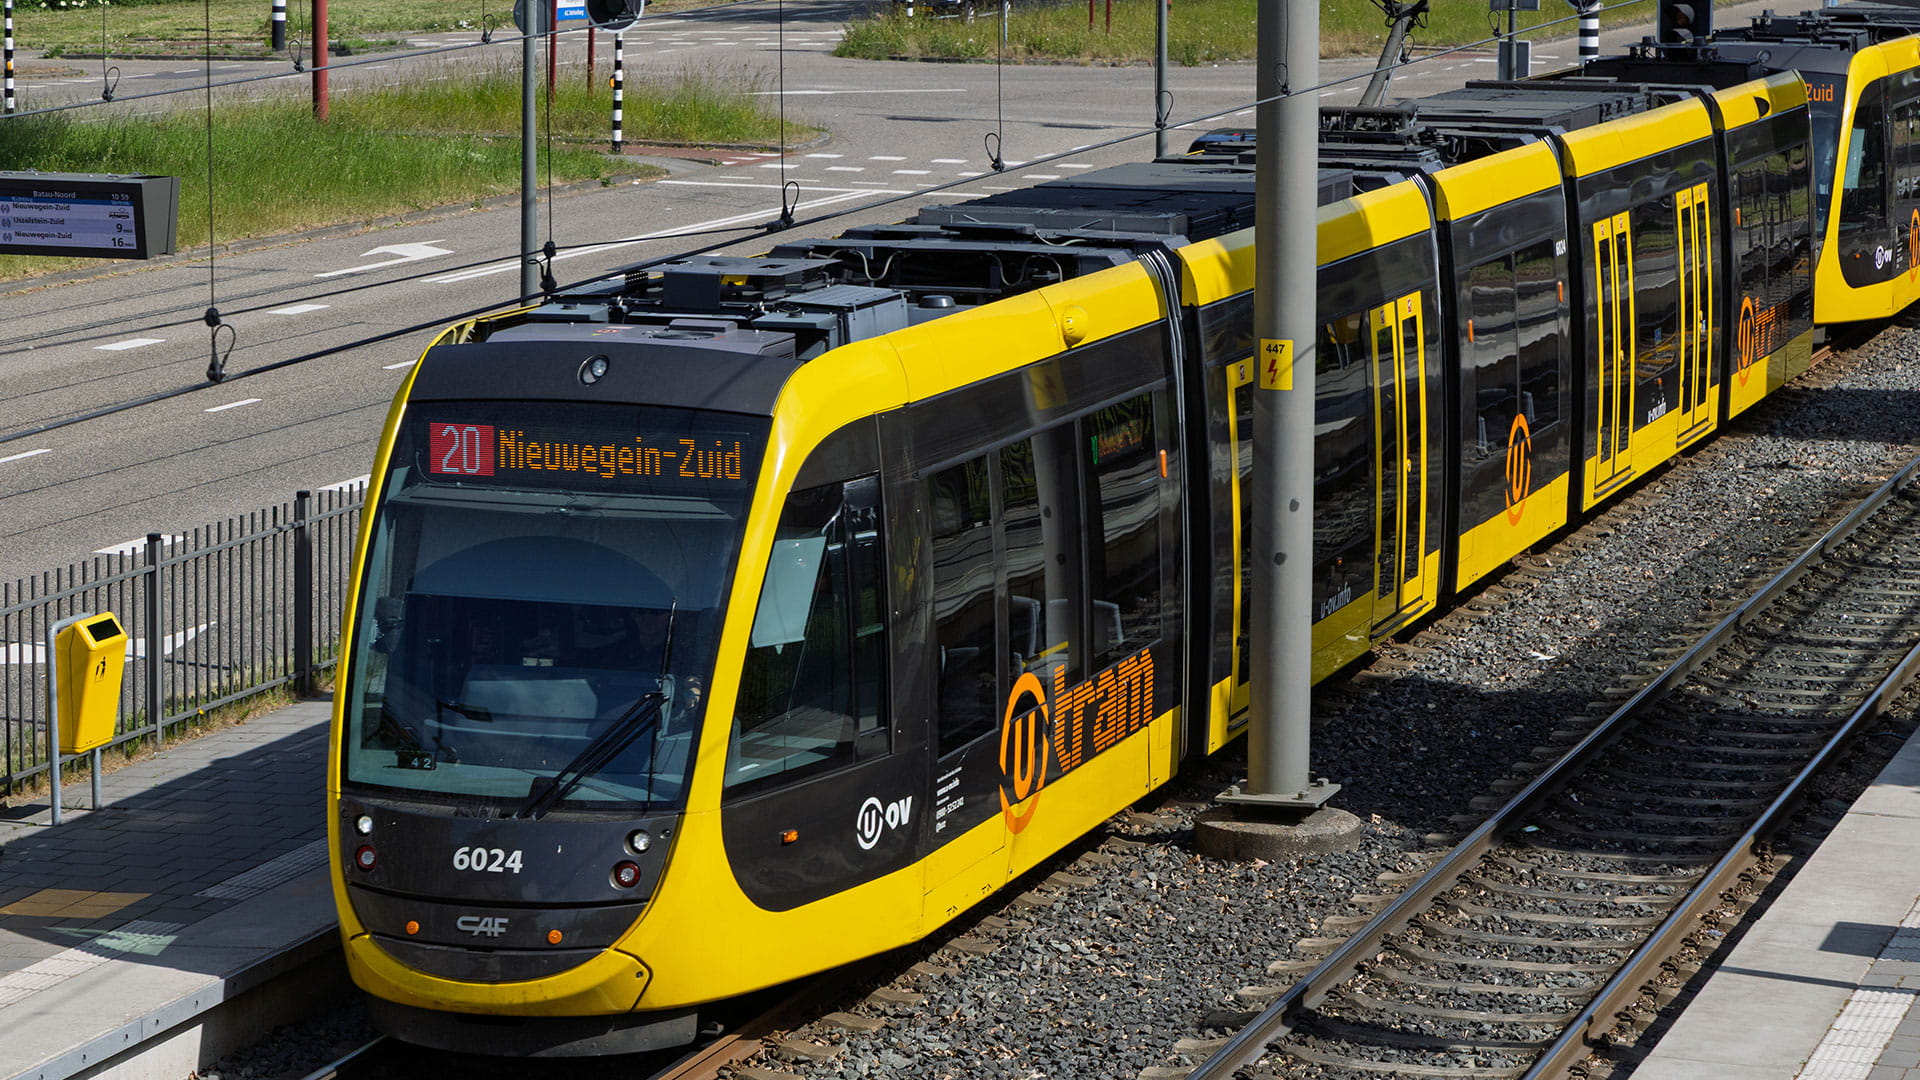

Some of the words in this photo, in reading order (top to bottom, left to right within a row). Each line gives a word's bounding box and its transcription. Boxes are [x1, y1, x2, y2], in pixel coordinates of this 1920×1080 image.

[1806, 83, 1834, 102] Zuid
[12, 202, 71, 211] Nieuwegein-Zuid
[14, 231, 73, 240] Nieuwegein-Zuid
[116, 223, 123, 233] 9
[111, 237, 124, 247] 16
[1265, 343, 1286, 354] 447
[442, 425, 480, 473] 20
[500, 430, 741, 479] Nieuwegein-Zuid
[1054, 648, 1154, 773] tram
[453, 846, 523, 873] 6024
[456, 915, 509, 937] CAF
